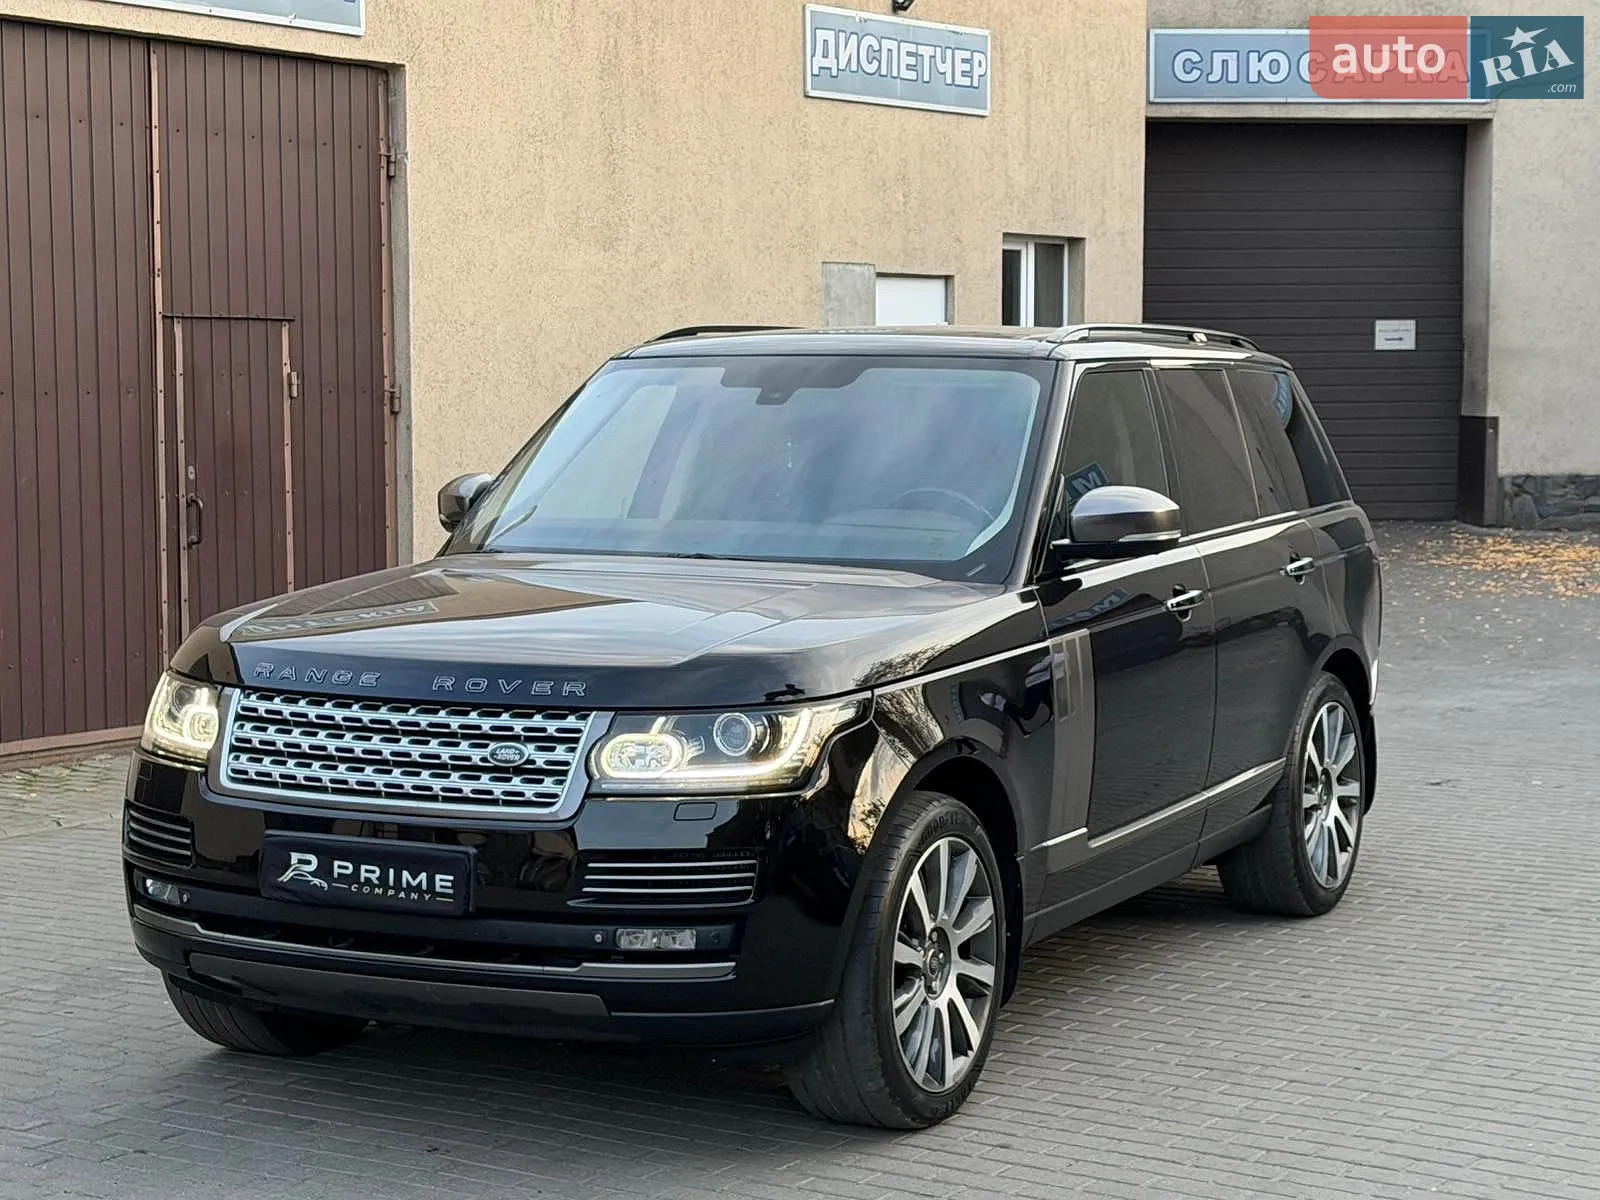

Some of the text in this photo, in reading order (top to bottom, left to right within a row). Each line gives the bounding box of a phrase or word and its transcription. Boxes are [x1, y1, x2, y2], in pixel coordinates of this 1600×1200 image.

[811, 28, 988, 89] ДИСПЕТЧЕР
[254, 661, 587, 697] RANGE ROVER
[332, 860, 455, 894] PRIME
[350, 883, 432, 901] COMPANY
